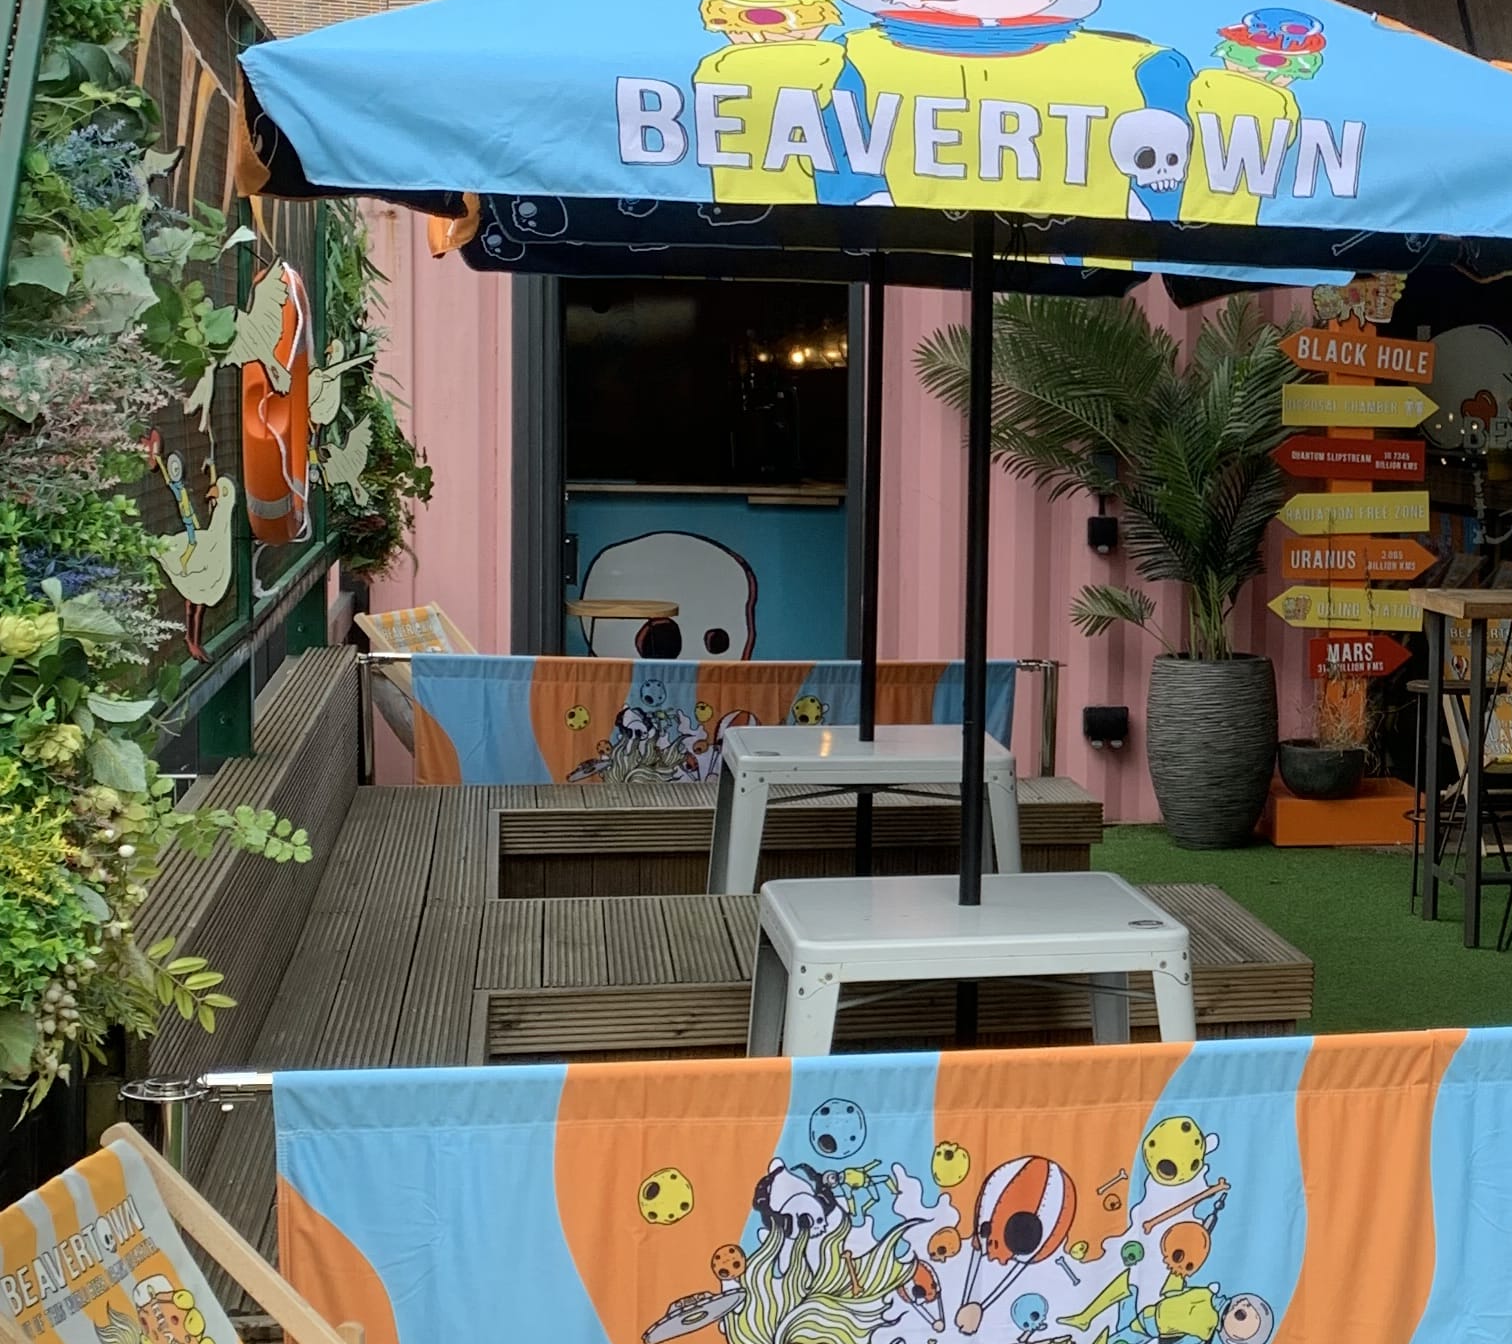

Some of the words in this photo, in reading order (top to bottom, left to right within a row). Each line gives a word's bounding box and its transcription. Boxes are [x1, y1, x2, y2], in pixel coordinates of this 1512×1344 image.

[614, 74, 1364, 199] BEAVERTOWN
[1297, 335, 1368, 367] BLACK
[1377, 345, 1429, 375] HOLE
[1291, 450, 1326, 462] QUANTUM
[1326, 452, 1372, 464] SLIPSTREAM
[1359, 506, 1389, 519] FREE
[1394, 506, 1425, 519] ZONE
[1290, 549, 1357, 569] URANUS
[1327, 642, 1375, 663] MARS
[0, 1194, 145, 1317] BEAVERTOWN
